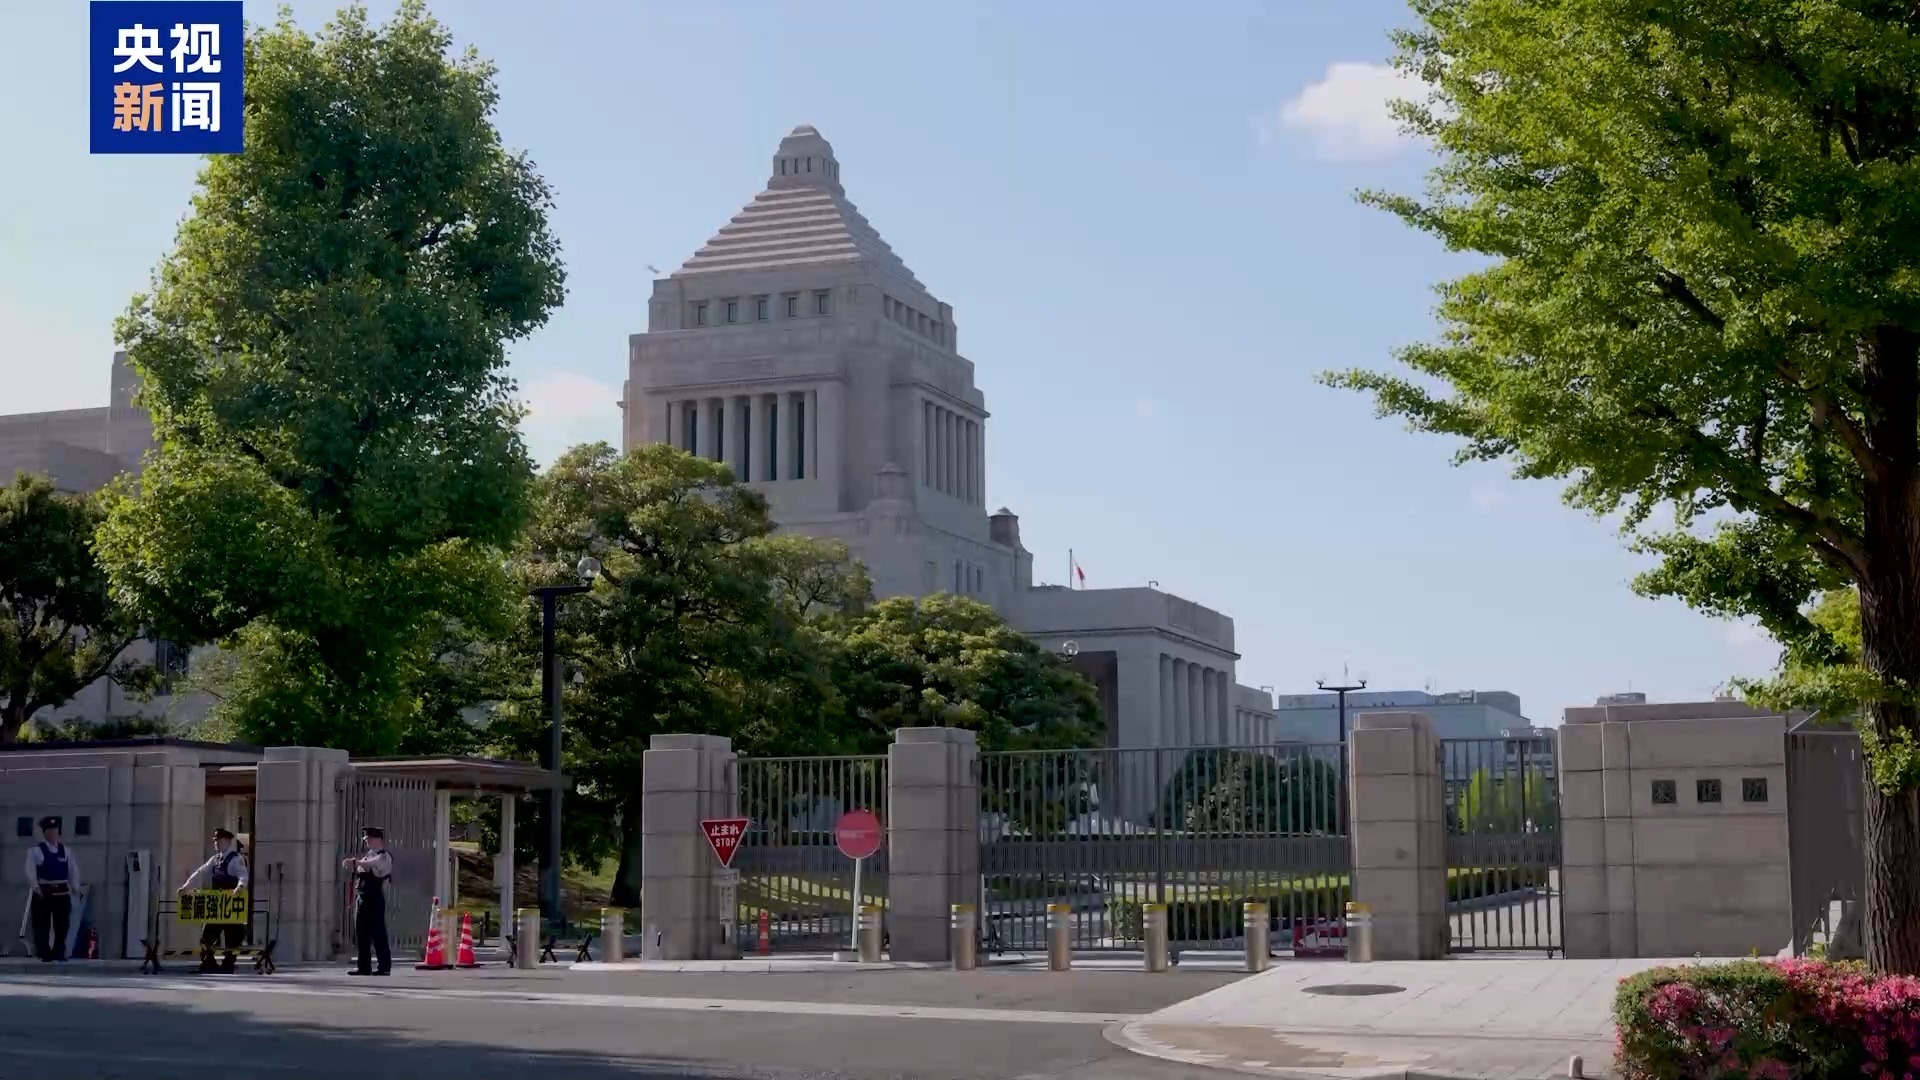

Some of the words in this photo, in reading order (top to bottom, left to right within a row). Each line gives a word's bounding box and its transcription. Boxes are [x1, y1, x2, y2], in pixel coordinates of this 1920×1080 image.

[710, 824, 739, 836] 止まれ
[715, 837, 735, 848] STOP
[180, 894, 244, 920] 警備強化中
